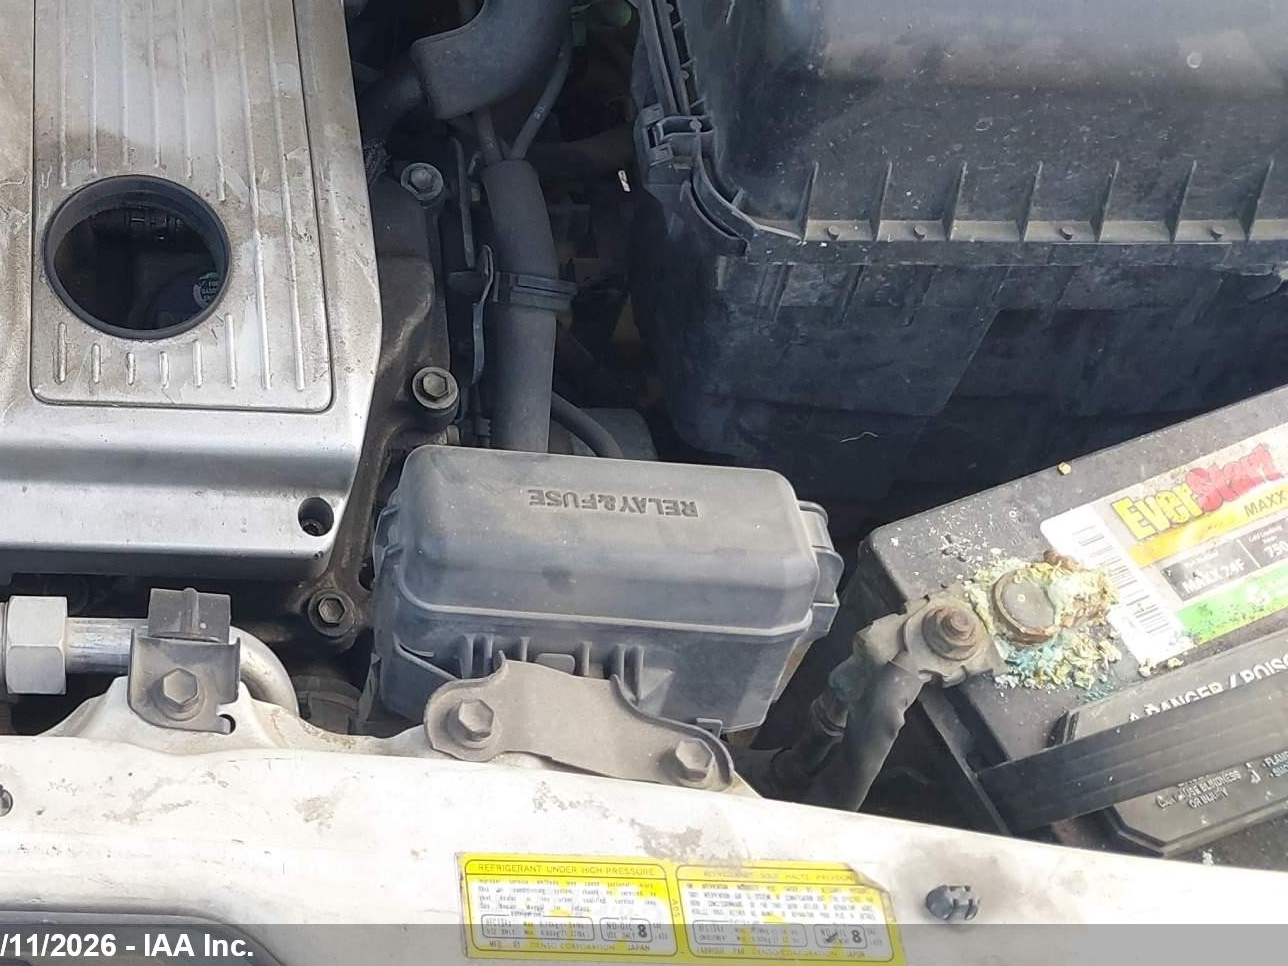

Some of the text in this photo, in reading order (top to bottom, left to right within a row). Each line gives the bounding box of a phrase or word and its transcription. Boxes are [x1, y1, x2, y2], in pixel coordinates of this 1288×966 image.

[478, 863, 541, 874] REFRIGERANT
[546, 866, 577, 875] UNDER
[606, 867, 656, 876] PRESSURE
